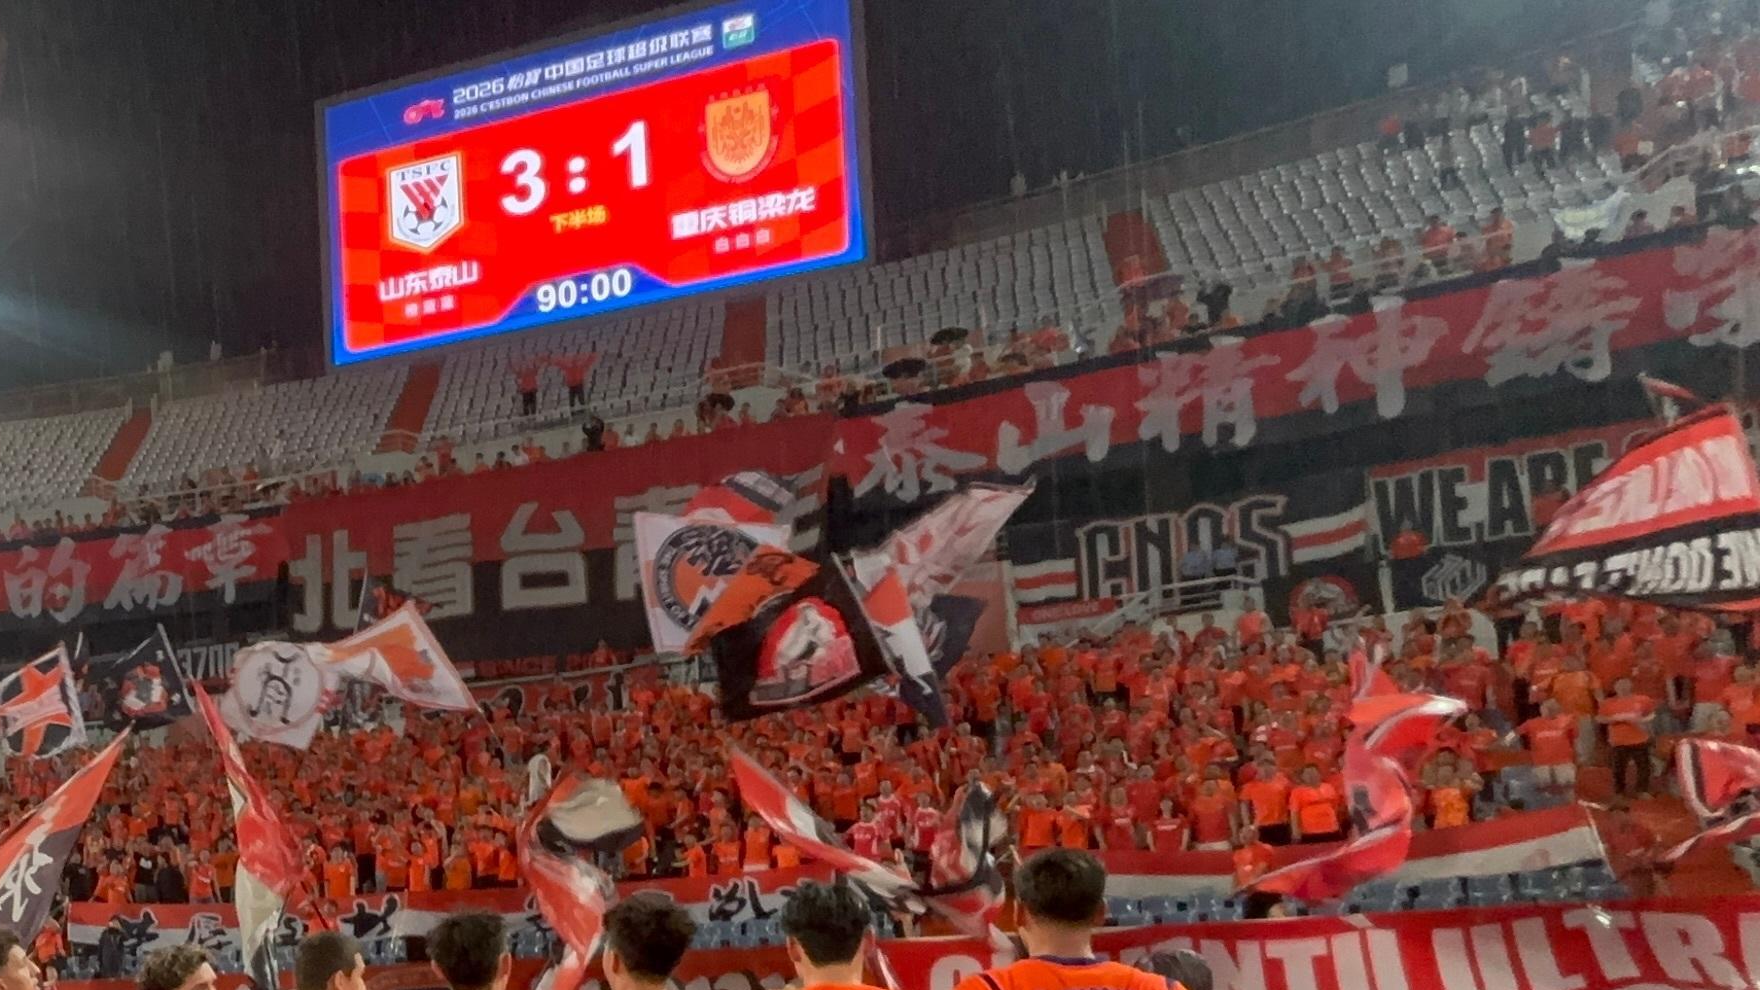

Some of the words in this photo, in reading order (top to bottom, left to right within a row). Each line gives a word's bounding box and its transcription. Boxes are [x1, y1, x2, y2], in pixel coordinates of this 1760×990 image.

[453, 77, 504, 105] 2026
[454, 106, 478, 120] 2026
[531, 80, 574, 99] CHINESE
[576, 66, 631, 89] FOOTBALL
[633, 58, 668, 75] SUPER
[670, 45, 714, 64] LEAGUE
[499, 148, 546, 216] 3
[612, 120, 652, 189] 1
[549, 205, 608, 234] 下半场
[671, 186, 816, 240] 重庆铜梁龙
[379, 259, 480, 302] 山东泰山
[536, 268, 632, 313] 90:00
[1372, 464, 1474, 556] WE
